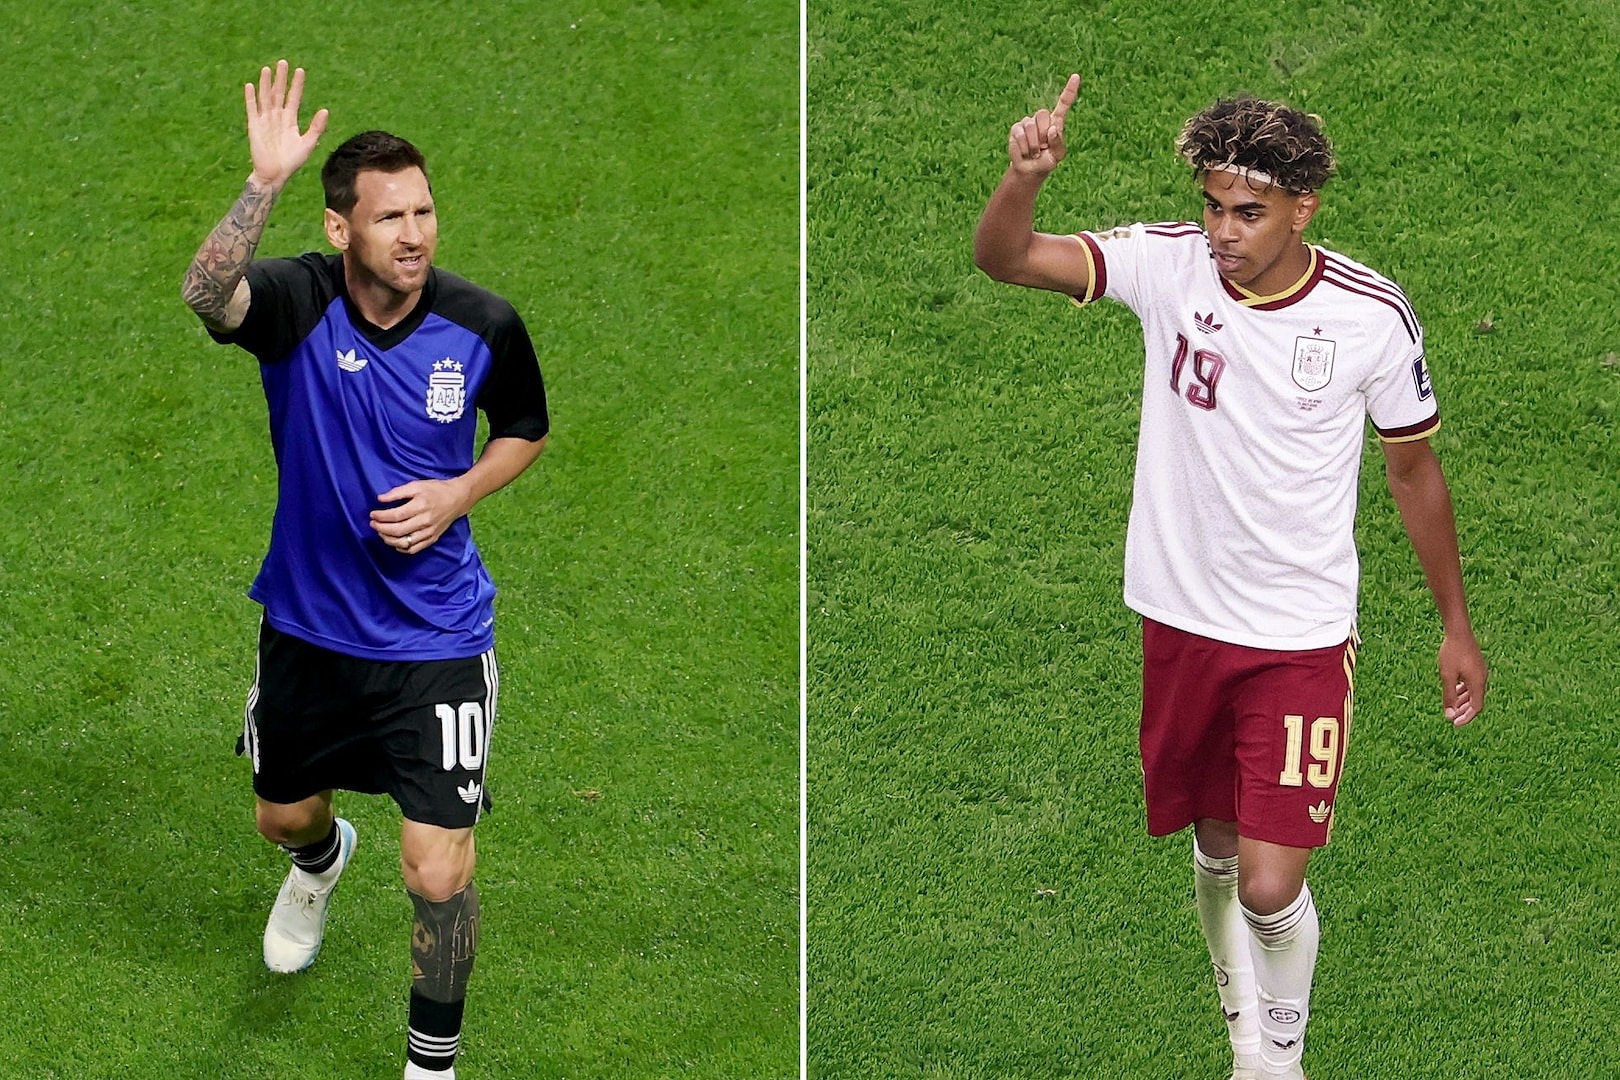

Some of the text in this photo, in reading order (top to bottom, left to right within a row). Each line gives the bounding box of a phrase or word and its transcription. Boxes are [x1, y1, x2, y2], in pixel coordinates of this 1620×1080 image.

[436, 386, 456, 407] AFA
[1169, 331, 1227, 411] 19
[435, 702, 484, 771] 10
[1279, 715, 1339, 788] 19
